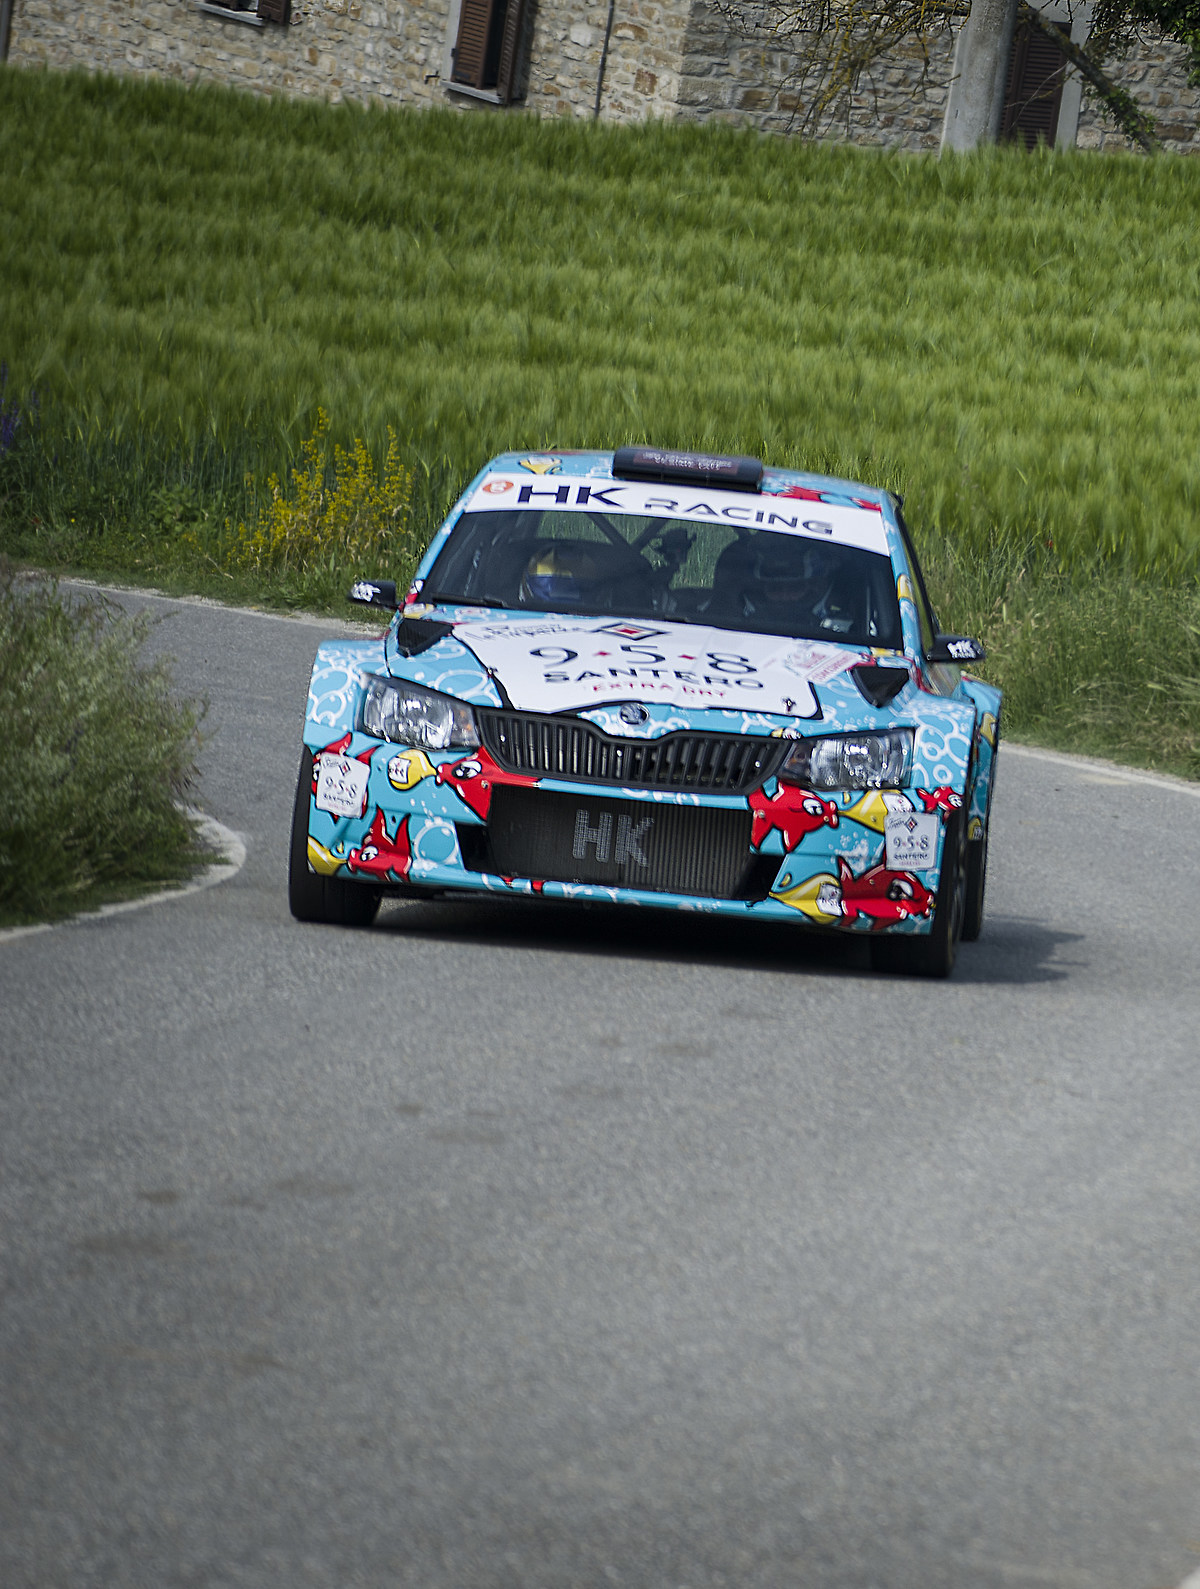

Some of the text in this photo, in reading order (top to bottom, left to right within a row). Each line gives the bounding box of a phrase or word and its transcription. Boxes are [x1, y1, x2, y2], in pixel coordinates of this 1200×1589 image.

[516, 484, 629, 508] HK
[644, 497, 835, 536] RACING
[543, 667, 764, 690] SANTERO
[572, 808, 655, 868] HK
